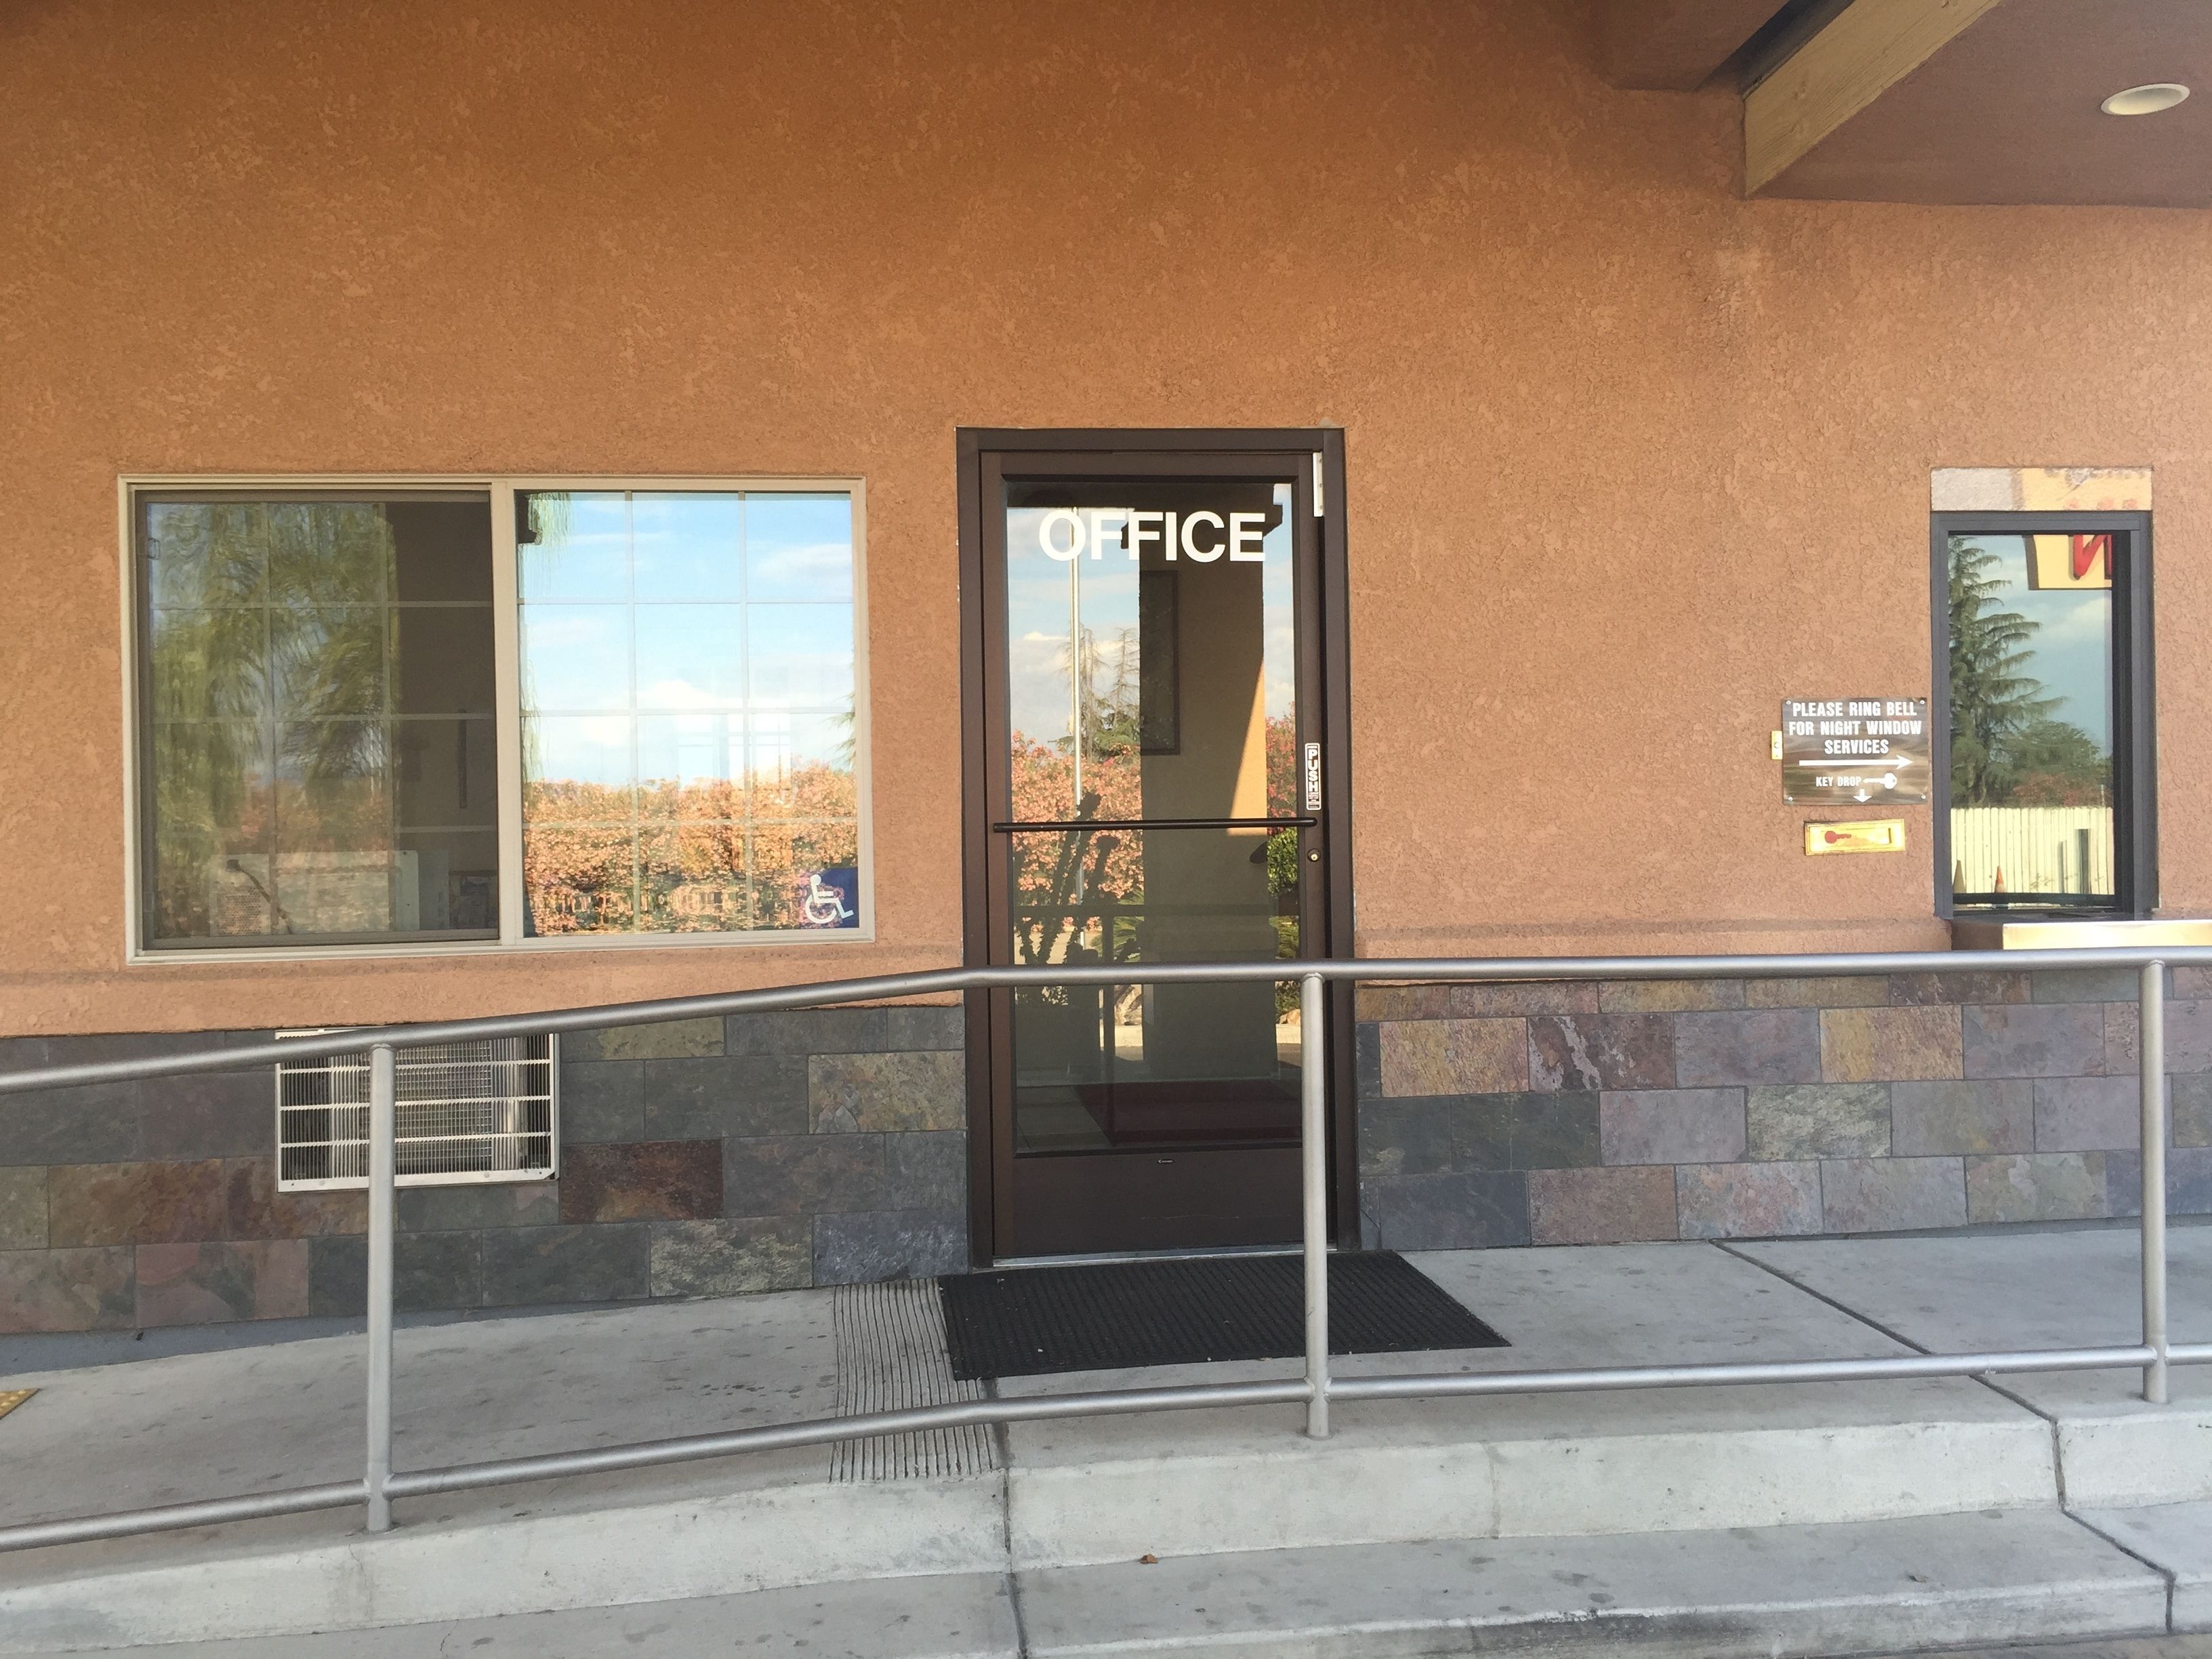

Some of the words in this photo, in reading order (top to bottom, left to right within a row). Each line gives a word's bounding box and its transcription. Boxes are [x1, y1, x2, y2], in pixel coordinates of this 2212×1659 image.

[1039, 509, 1266, 563] OFFICE
[1793, 702, 1843, 717] PLEASE
[1849, 701, 1881, 716] RING
[1886, 701, 1917, 716] BELL
[1788, 721, 1815, 736] FOR
[1820, 720, 1861, 735] NIGHT
[1866, 720, 1922, 735] WINDOW
[1824, 739, 1889, 754] SERVICES
[1308, 749, 1319, 792] PUSH
[1816, 776, 1833, 787] KEY
[1837, 776, 1862, 787] DROP
